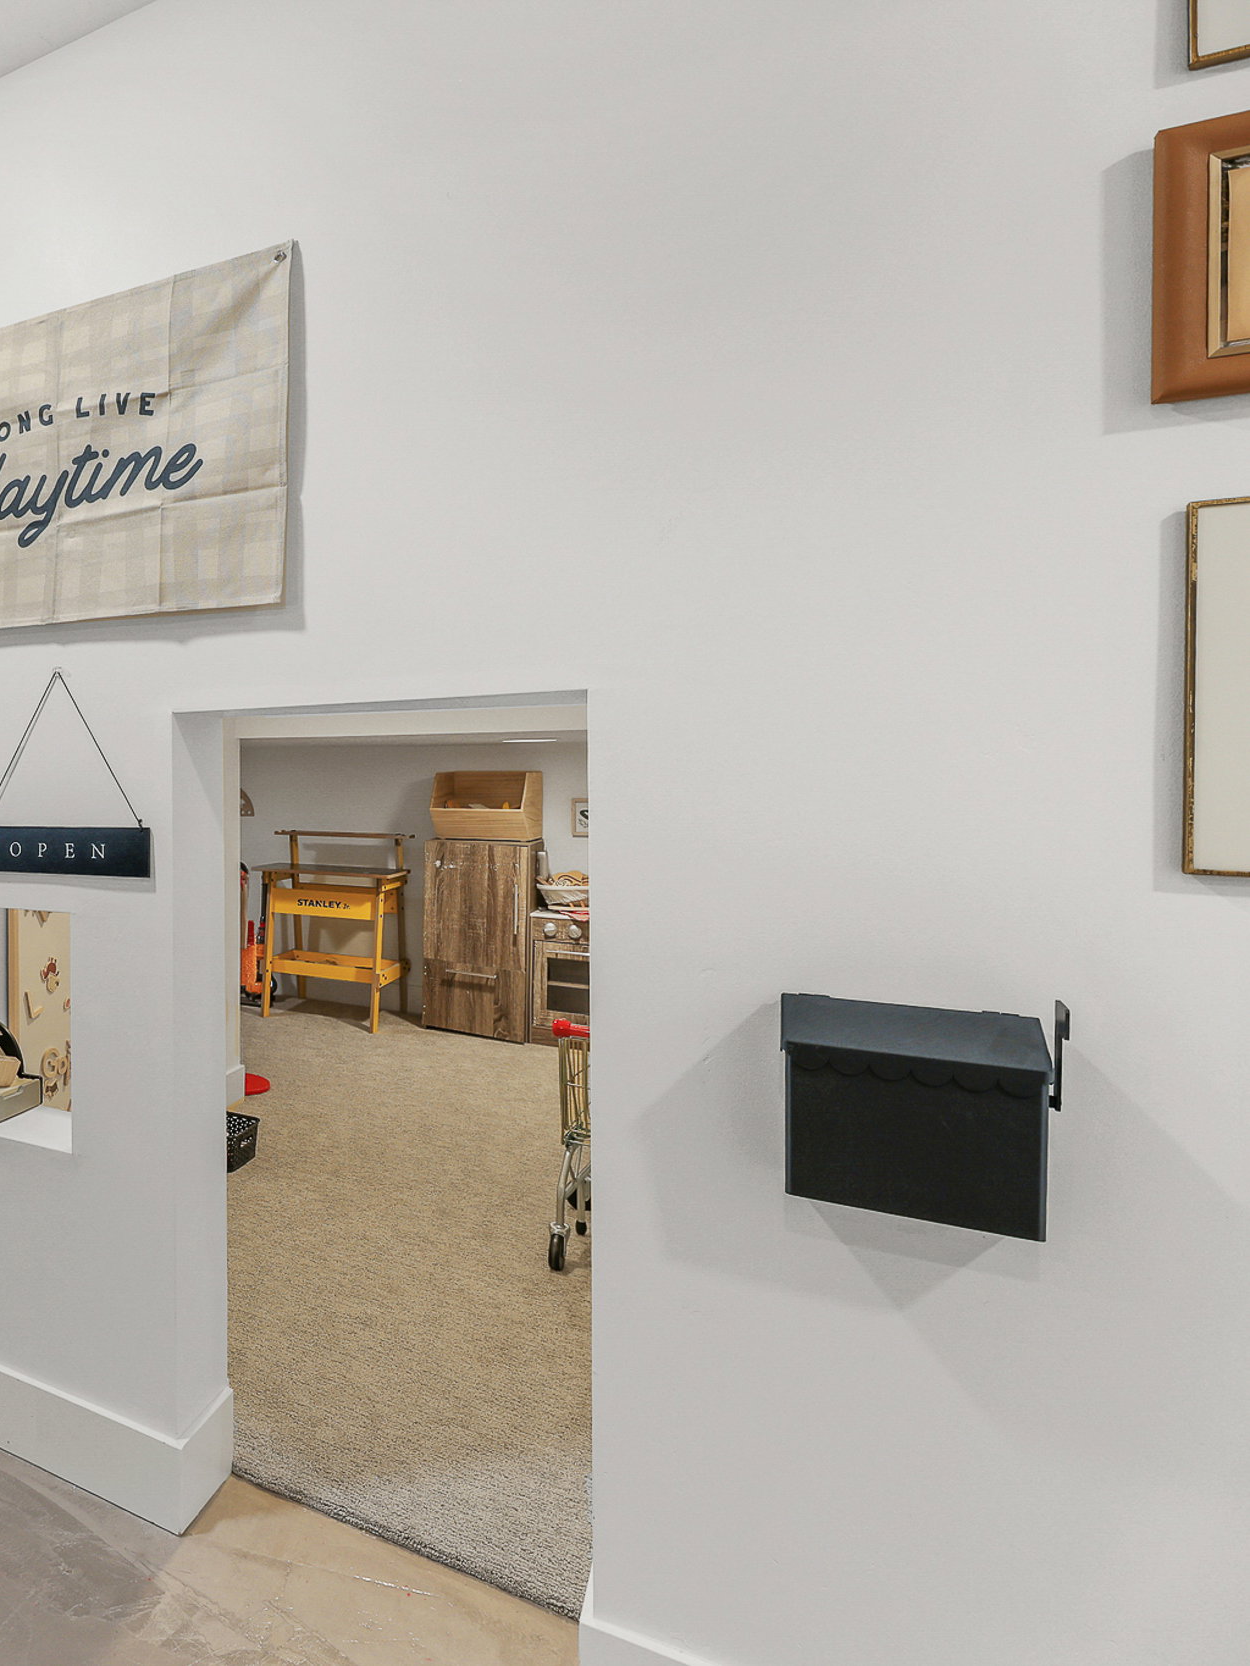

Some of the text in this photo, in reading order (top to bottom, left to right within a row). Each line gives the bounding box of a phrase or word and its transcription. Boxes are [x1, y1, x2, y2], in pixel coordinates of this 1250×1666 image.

[76, 391, 156, 418] LIVE
[9, 841, 106, 859] OPEN
[297, 898, 341, 909] STANLEY
